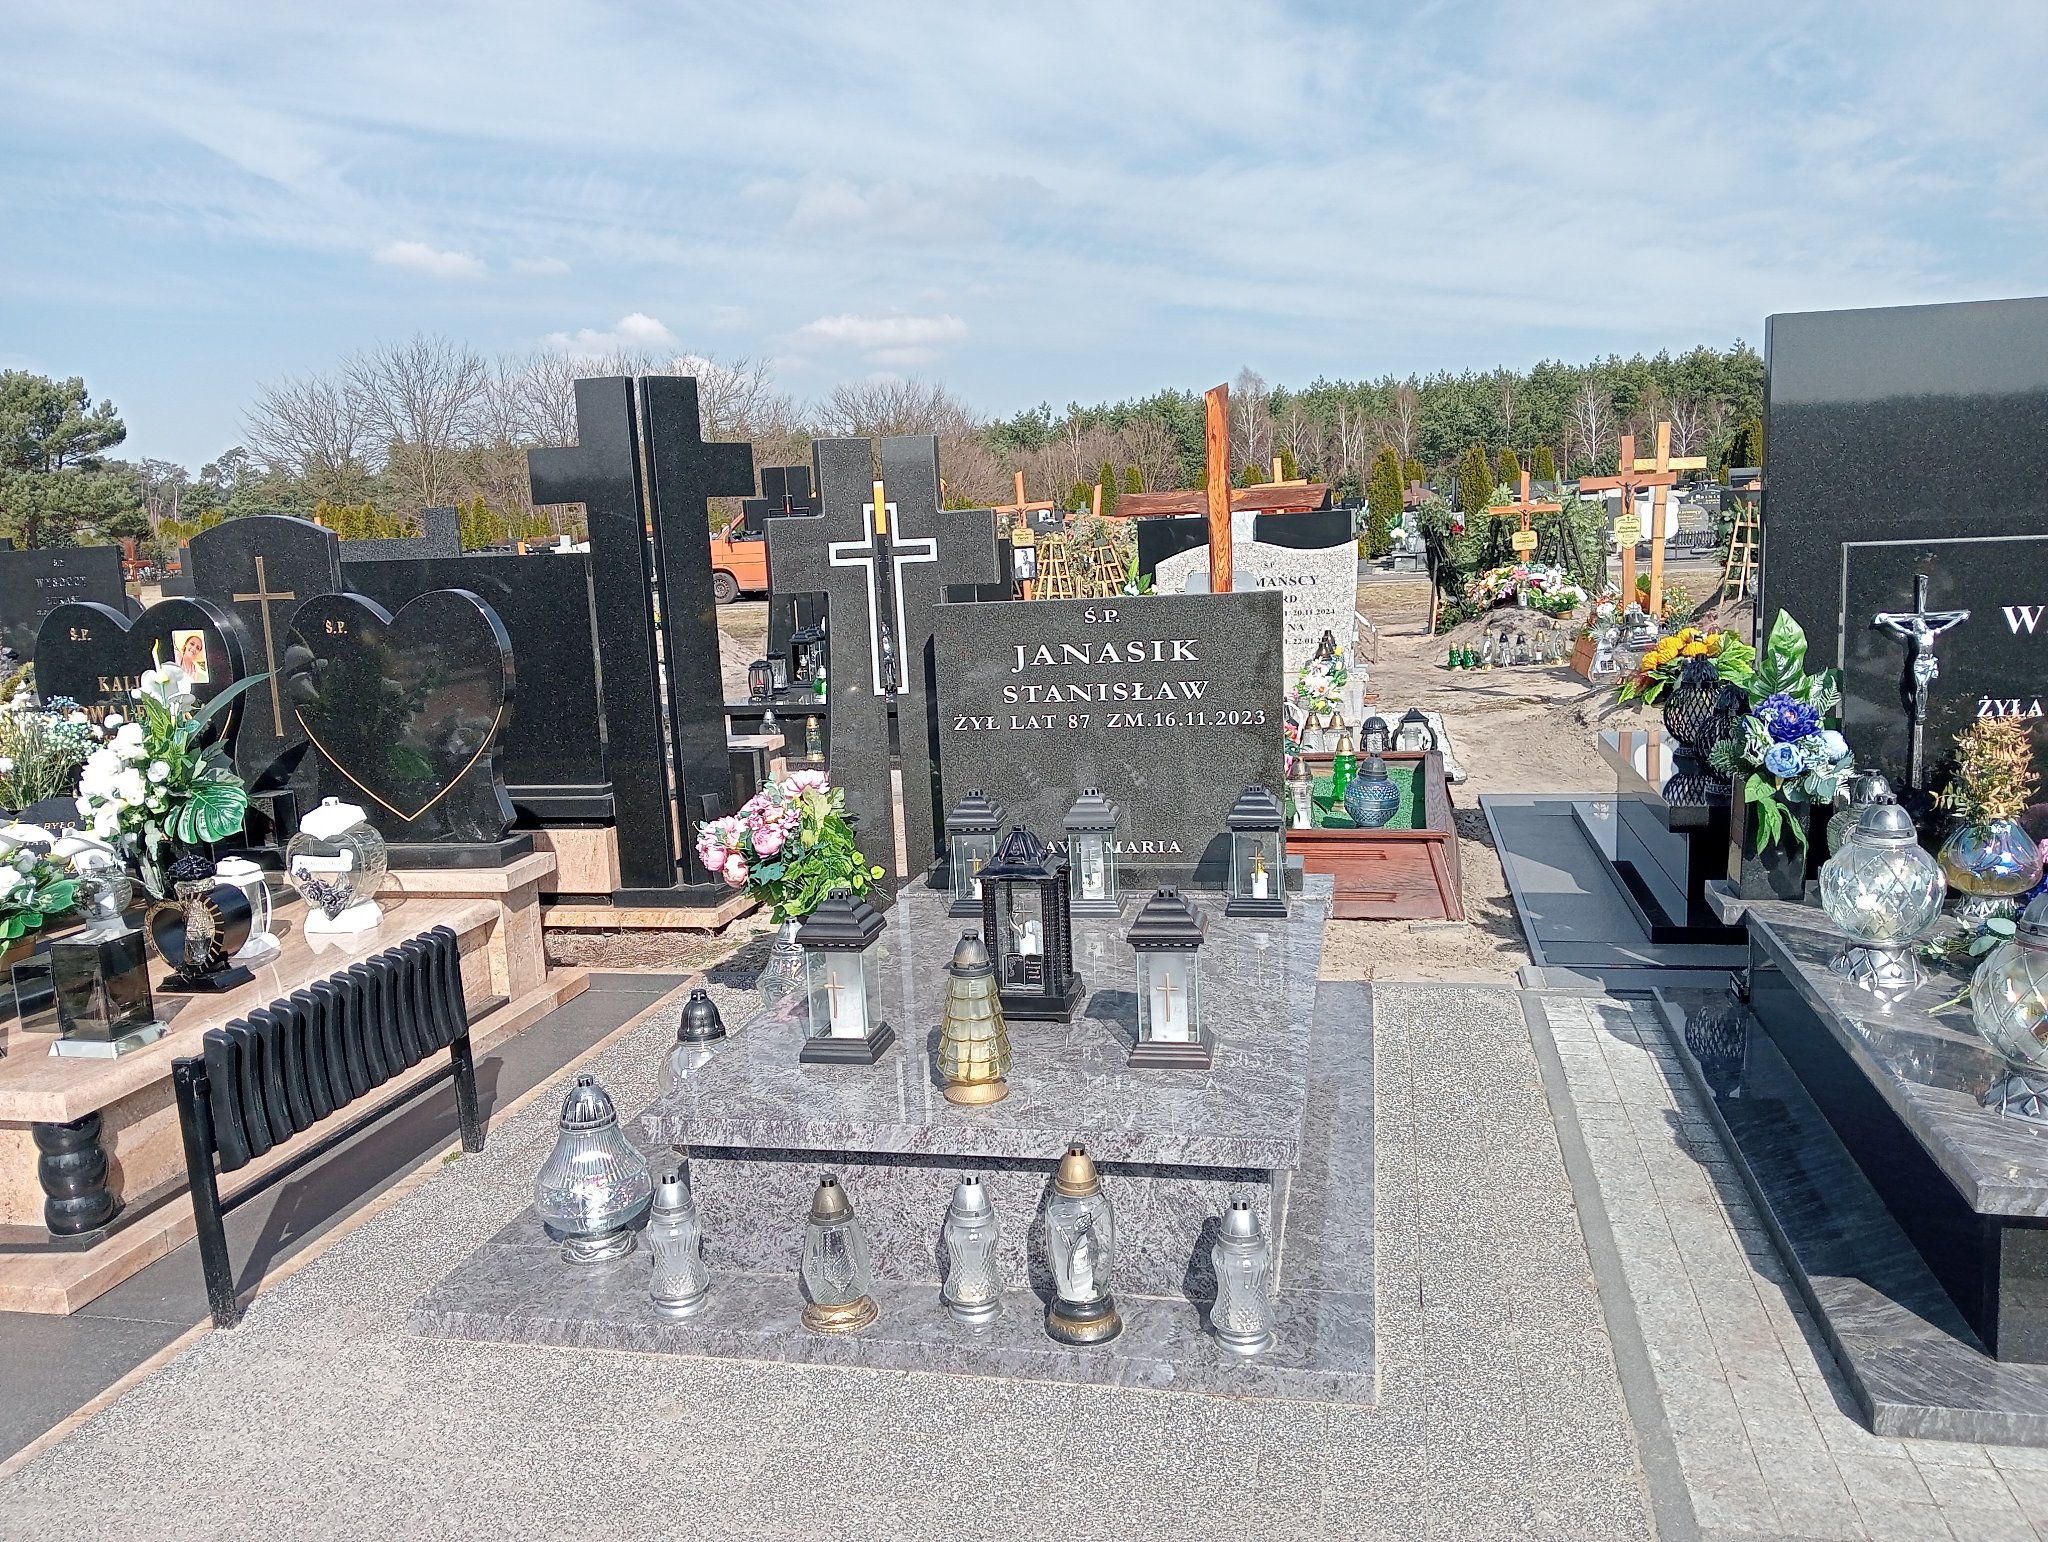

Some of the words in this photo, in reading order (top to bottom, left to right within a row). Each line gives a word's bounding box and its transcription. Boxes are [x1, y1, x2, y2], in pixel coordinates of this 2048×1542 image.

[1256, 573, 1318, 587] MAŃSCY
[1084, 606, 1121, 624] Ś.P.
[1010, 639, 1200, 674] JANASIK
[1002, 680, 1210, 704] STANISŁAW
[953, 714, 1001, 732] ŻYŁ
[1009, 714, 1057, 730] LAT
[1068, 713, 1090, 729] 87
[1106, 710, 1267, 729] ZM.16.11.2023
[1103, 840, 1184, 854] MARIA
